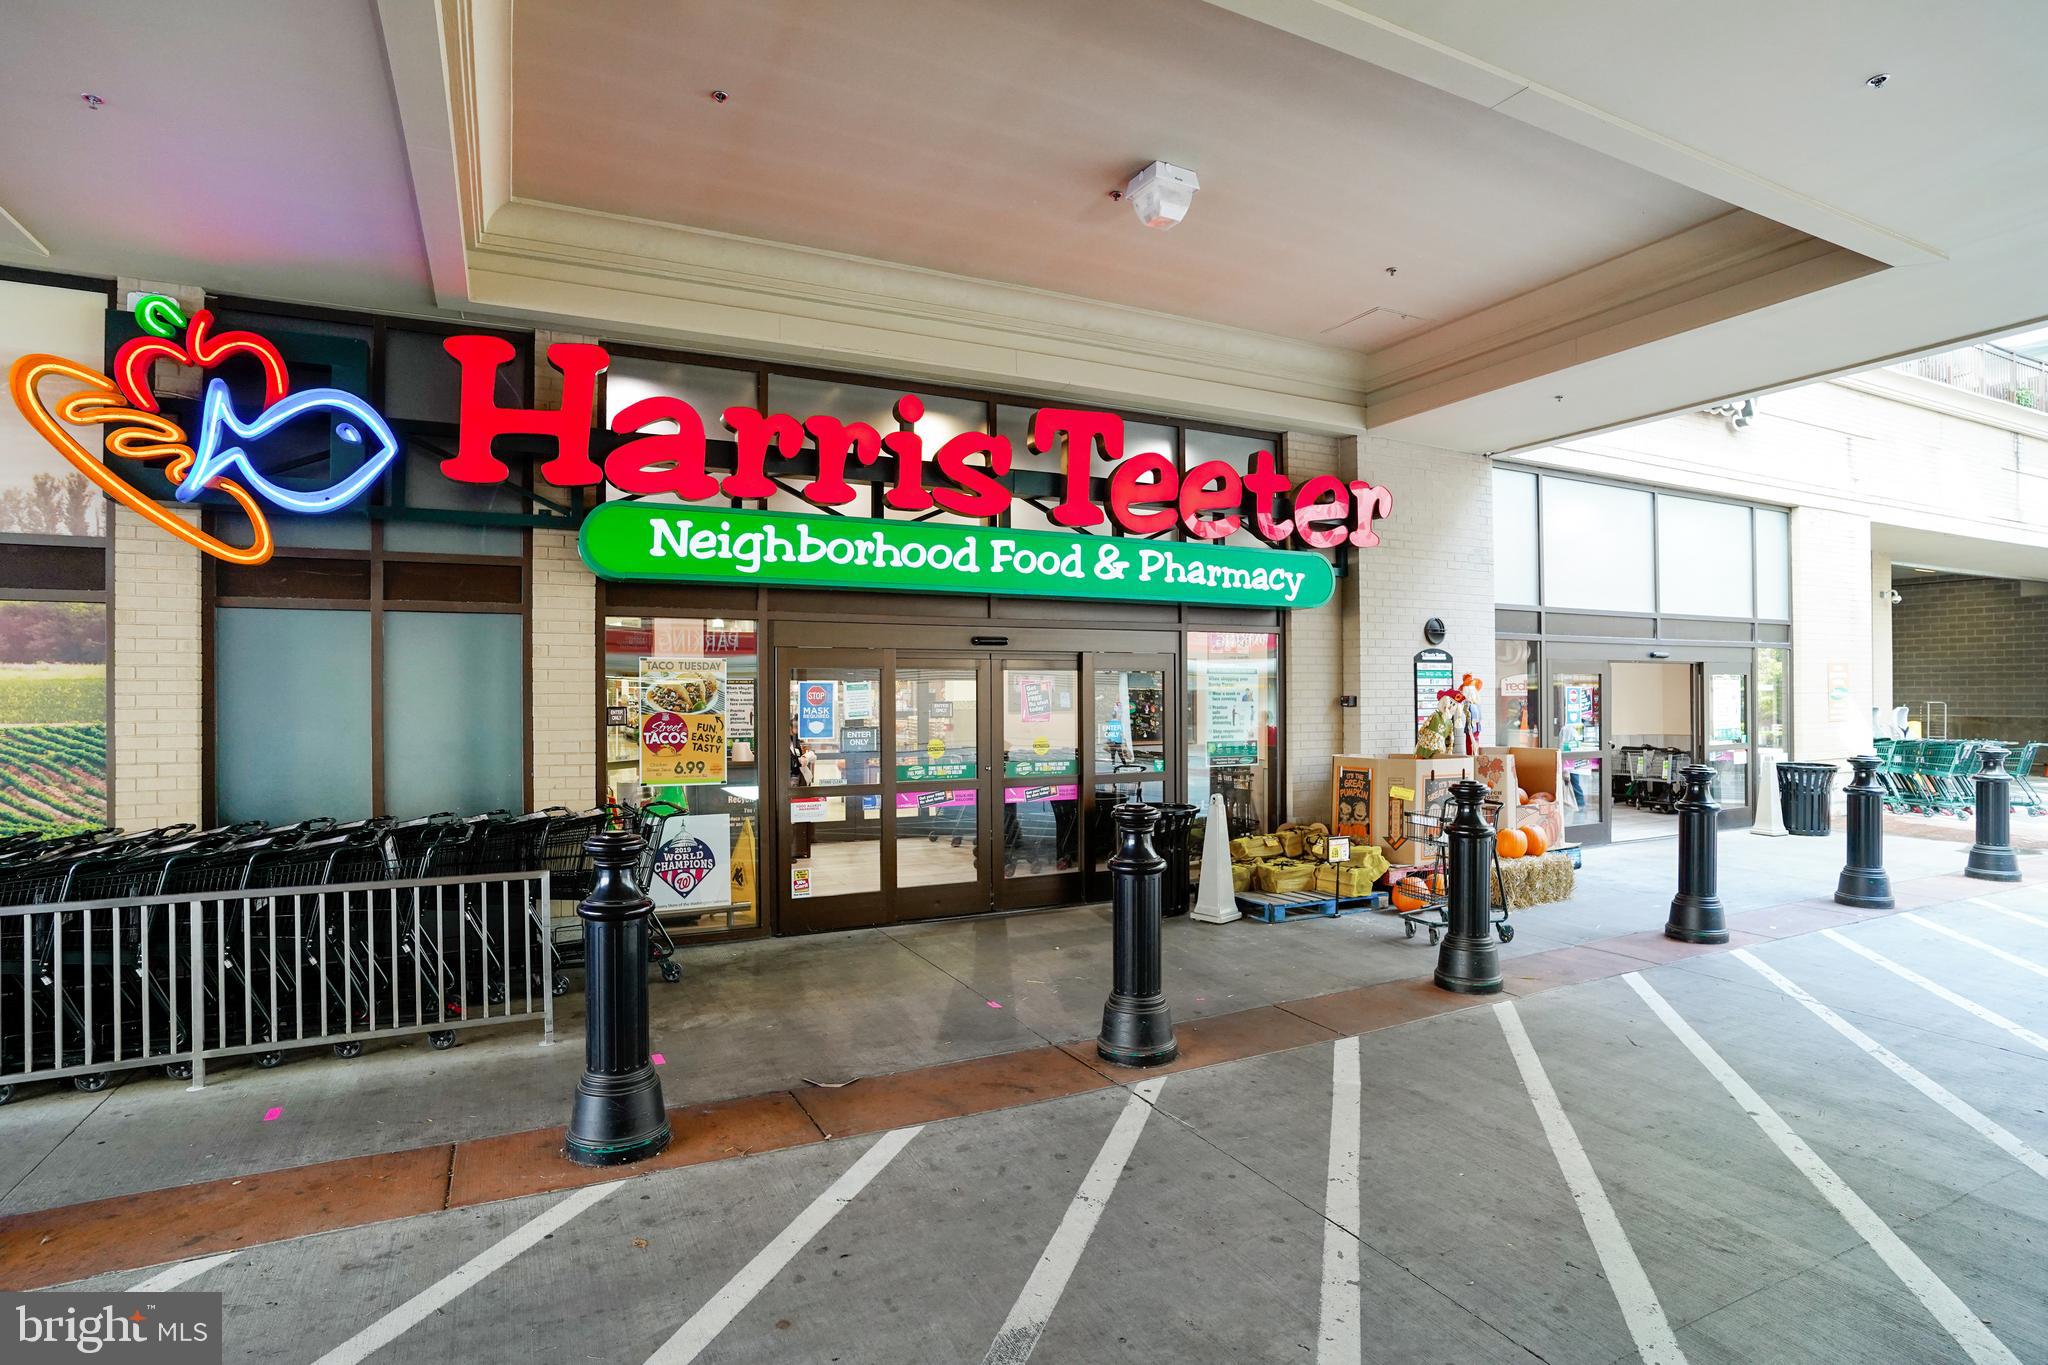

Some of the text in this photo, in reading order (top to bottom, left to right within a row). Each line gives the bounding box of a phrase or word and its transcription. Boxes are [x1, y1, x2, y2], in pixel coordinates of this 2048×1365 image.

[439, 334, 1393, 549] Harris Teeter
[649, 517, 1306, 602] Neighborhood Food & Pharmacy
[646, 660, 721, 671] TACO TUESDAY
[808, 692, 825, 700] STOP
[803, 706, 830, 715] MASK
[651, 721, 683, 733] Street
[643, 732, 688, 745] TACOS
[691, 732, 723, 744] EASY &
[847, 731, 871, 739] ENTER
[692, 742, 721, 754] TASTY
[674, 760, 705, 775] 6.99
[1344, 779, 1365, 789] GREAT
[1340, 788, 1368, 800] PUMPKIN
[663, 850, 704, 862] WORLD
[654, 858, 714, 873] CHAMPIONS
